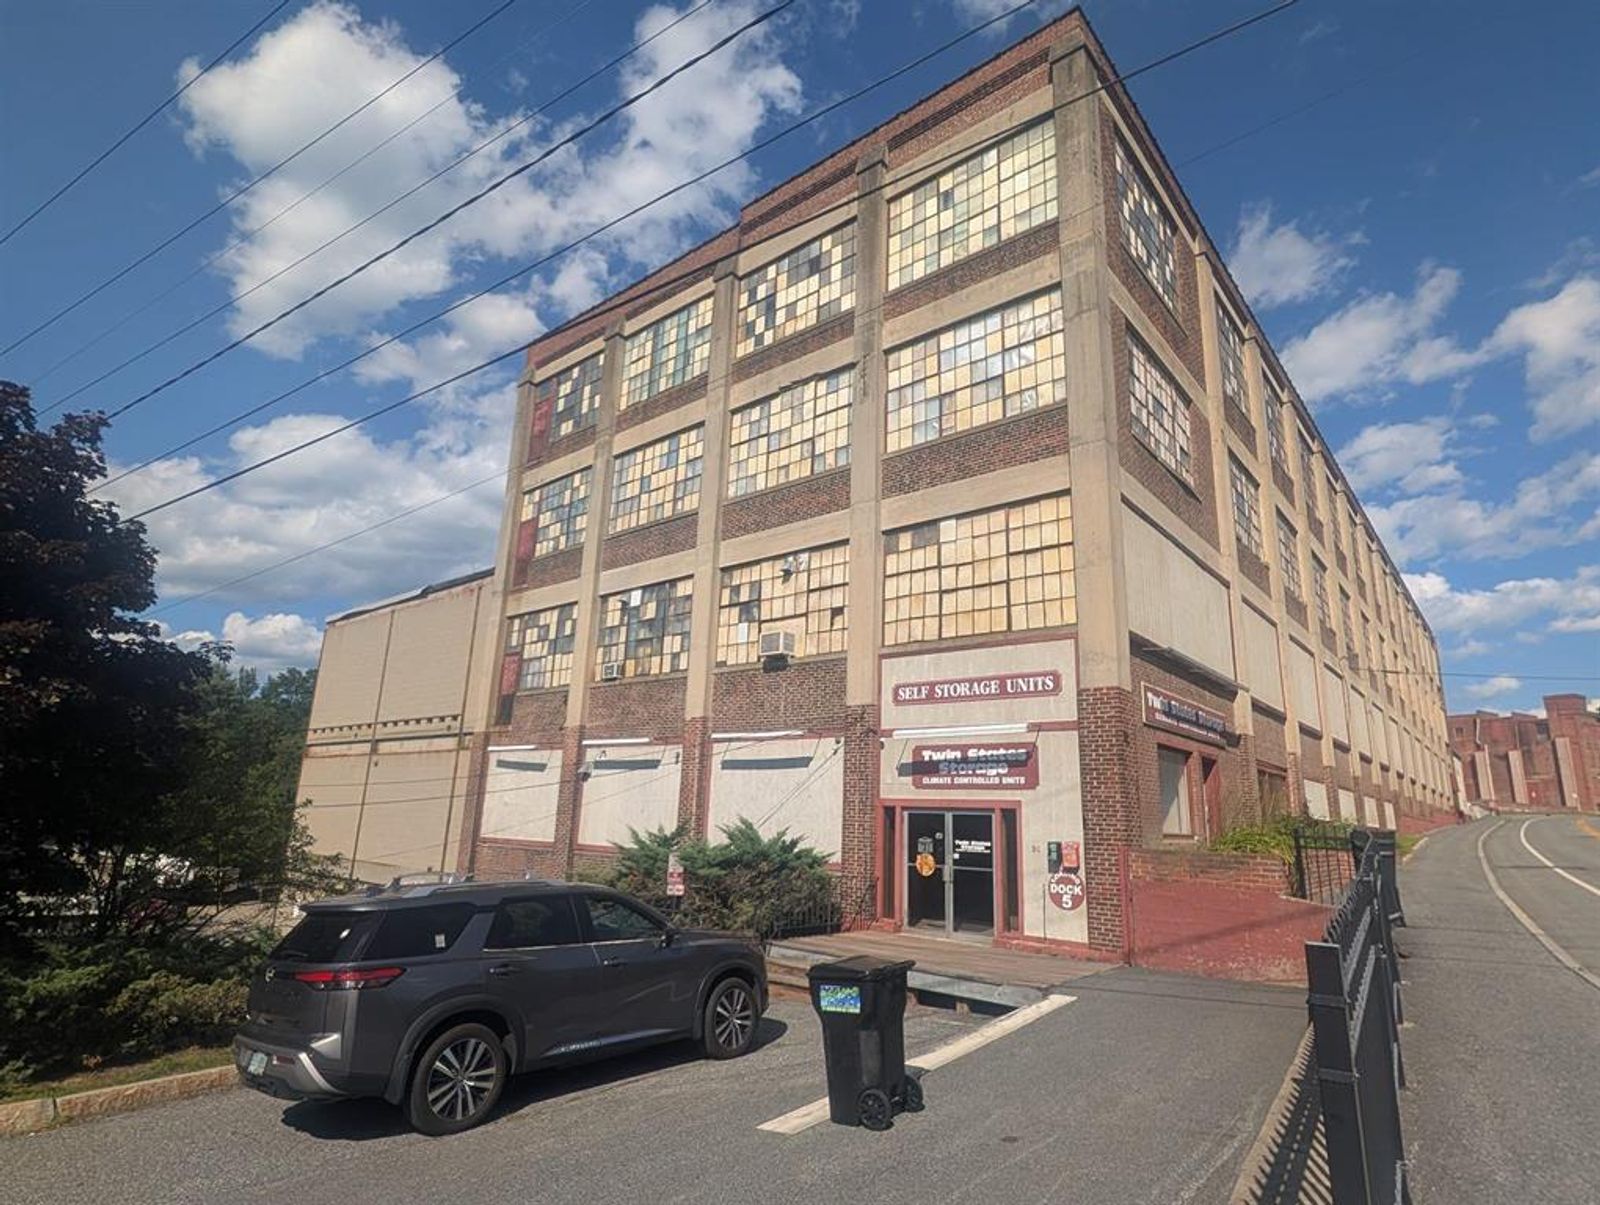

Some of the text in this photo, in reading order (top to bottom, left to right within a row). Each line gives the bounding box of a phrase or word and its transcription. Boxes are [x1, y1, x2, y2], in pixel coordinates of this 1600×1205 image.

[897, 675, 1055, 700] SELF STORAGE UNITS
[922, 749, 961, 761] Twin
[938, 762, 1009, 776] Storage
[1050, 884, 1082, 896] DOCK
[1062, 894, 1073, 908] 5
